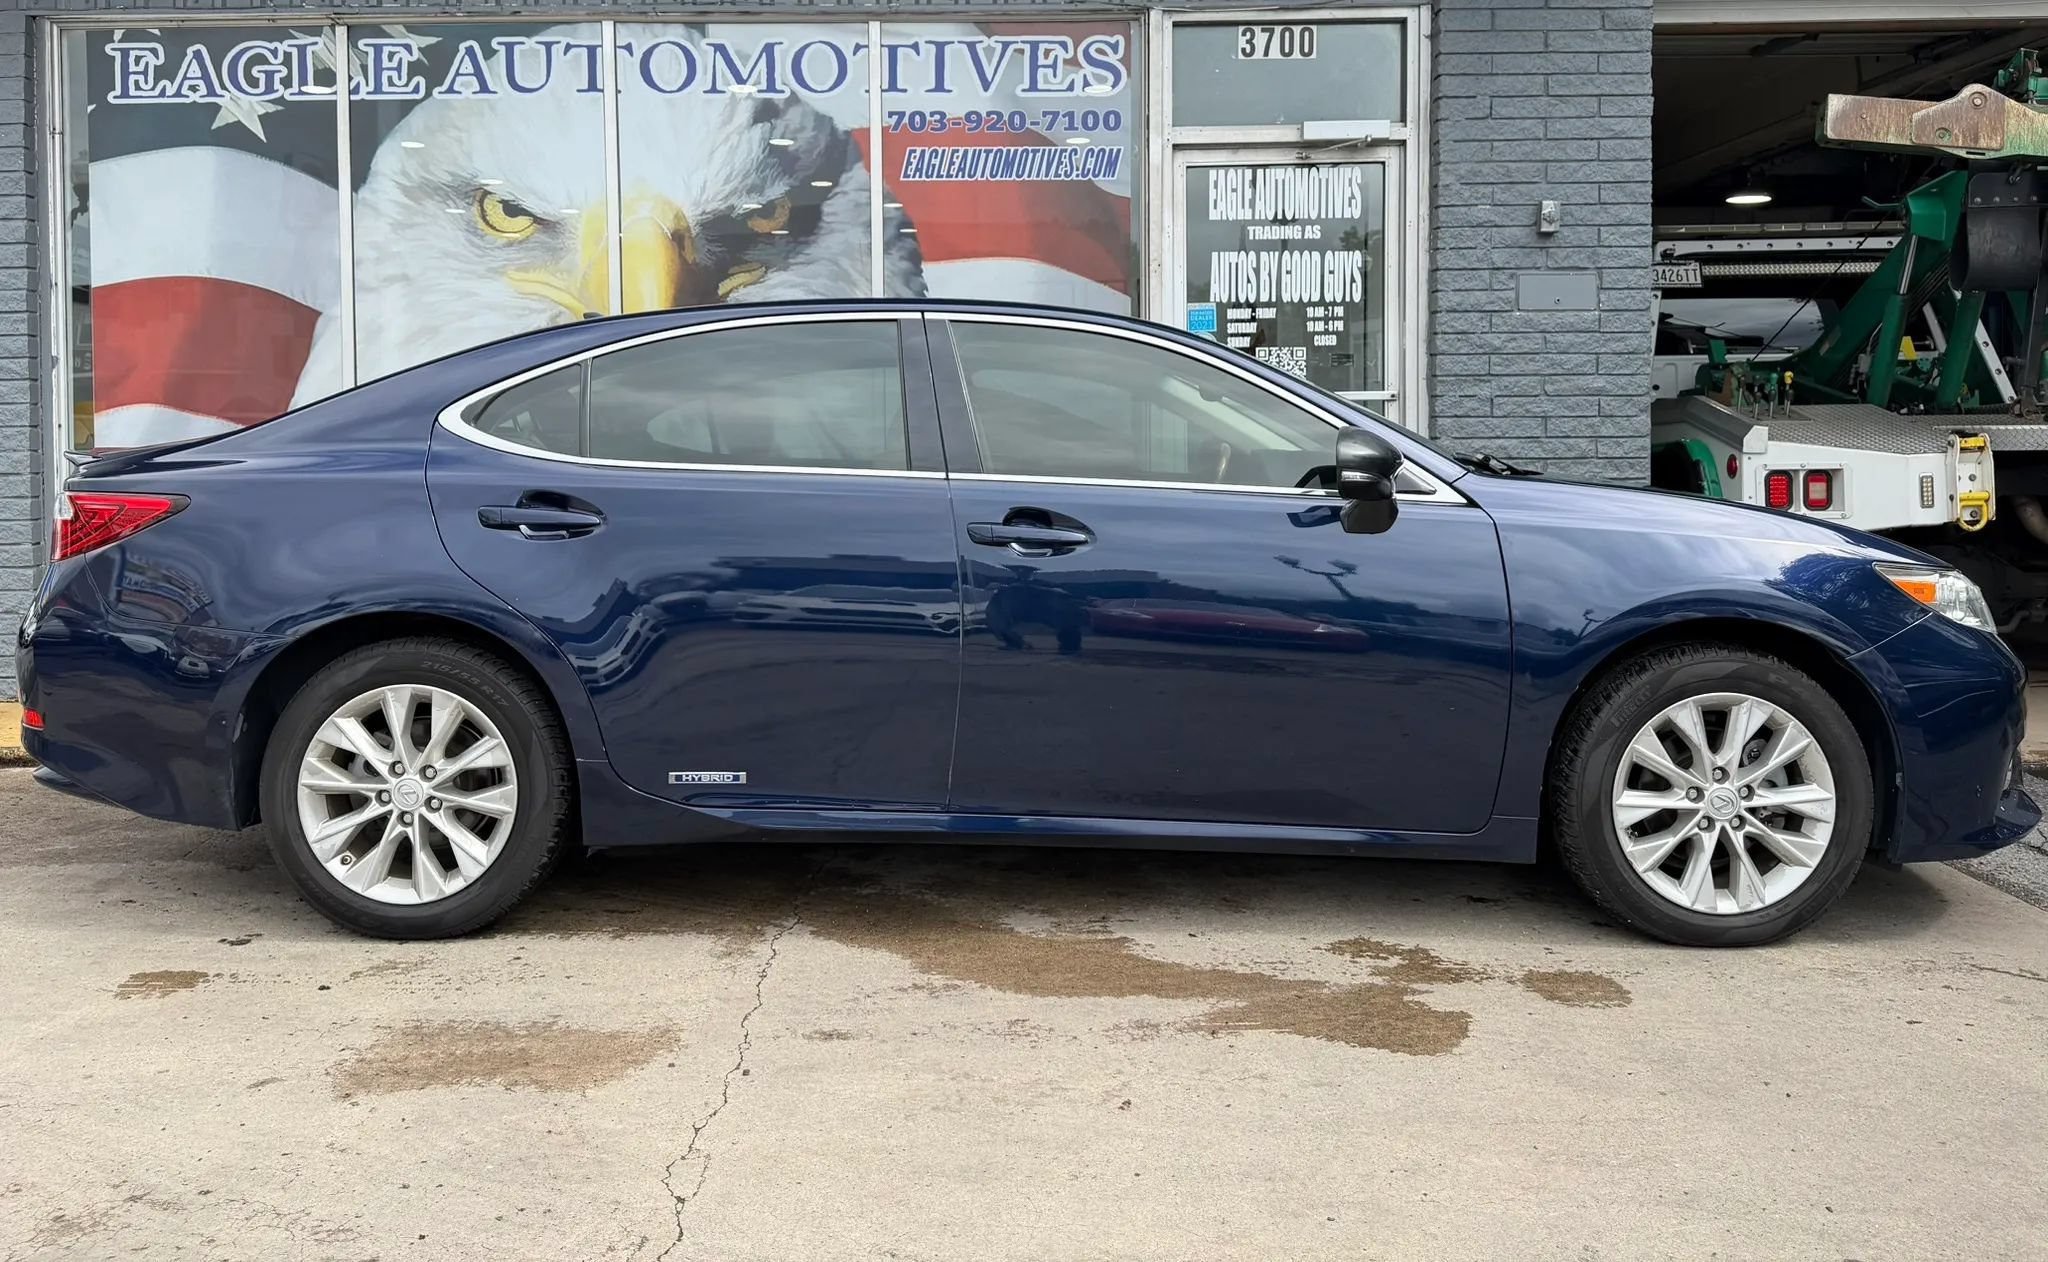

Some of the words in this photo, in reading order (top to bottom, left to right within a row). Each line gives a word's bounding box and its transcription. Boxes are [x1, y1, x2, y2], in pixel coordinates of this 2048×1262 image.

[1240, 26, 1314, 58] 3700
[105, 39, 426, 103] EAGLE
[434, 35, 1128, 99] AUTOMOTIVES
[887, 110, 1122, 132] 703-920-7100
[901, 146, 1123, 181] EAGLEAUTOMOTIVES.COM
[1209, 169, 1252, 220] EAGLE
[1255, 167, 1362, 220] AUTOMOTIVES
[1247, 226, 1301, 240] TRADING
[1304, 225, 1321, 239] AS
[1210, 251, 1257, 303] AUTOS
[1260, 251, 1279, 303] BY
[1281, 250, 1321, 303] GOOD
[1324, 250, 1362, 303] GUYS
[1227, 322, 1257, 334] SATURDAY
[1314, 334, 1337, 346] CLOSED
[681, 773, 734, 782] HYBRID
